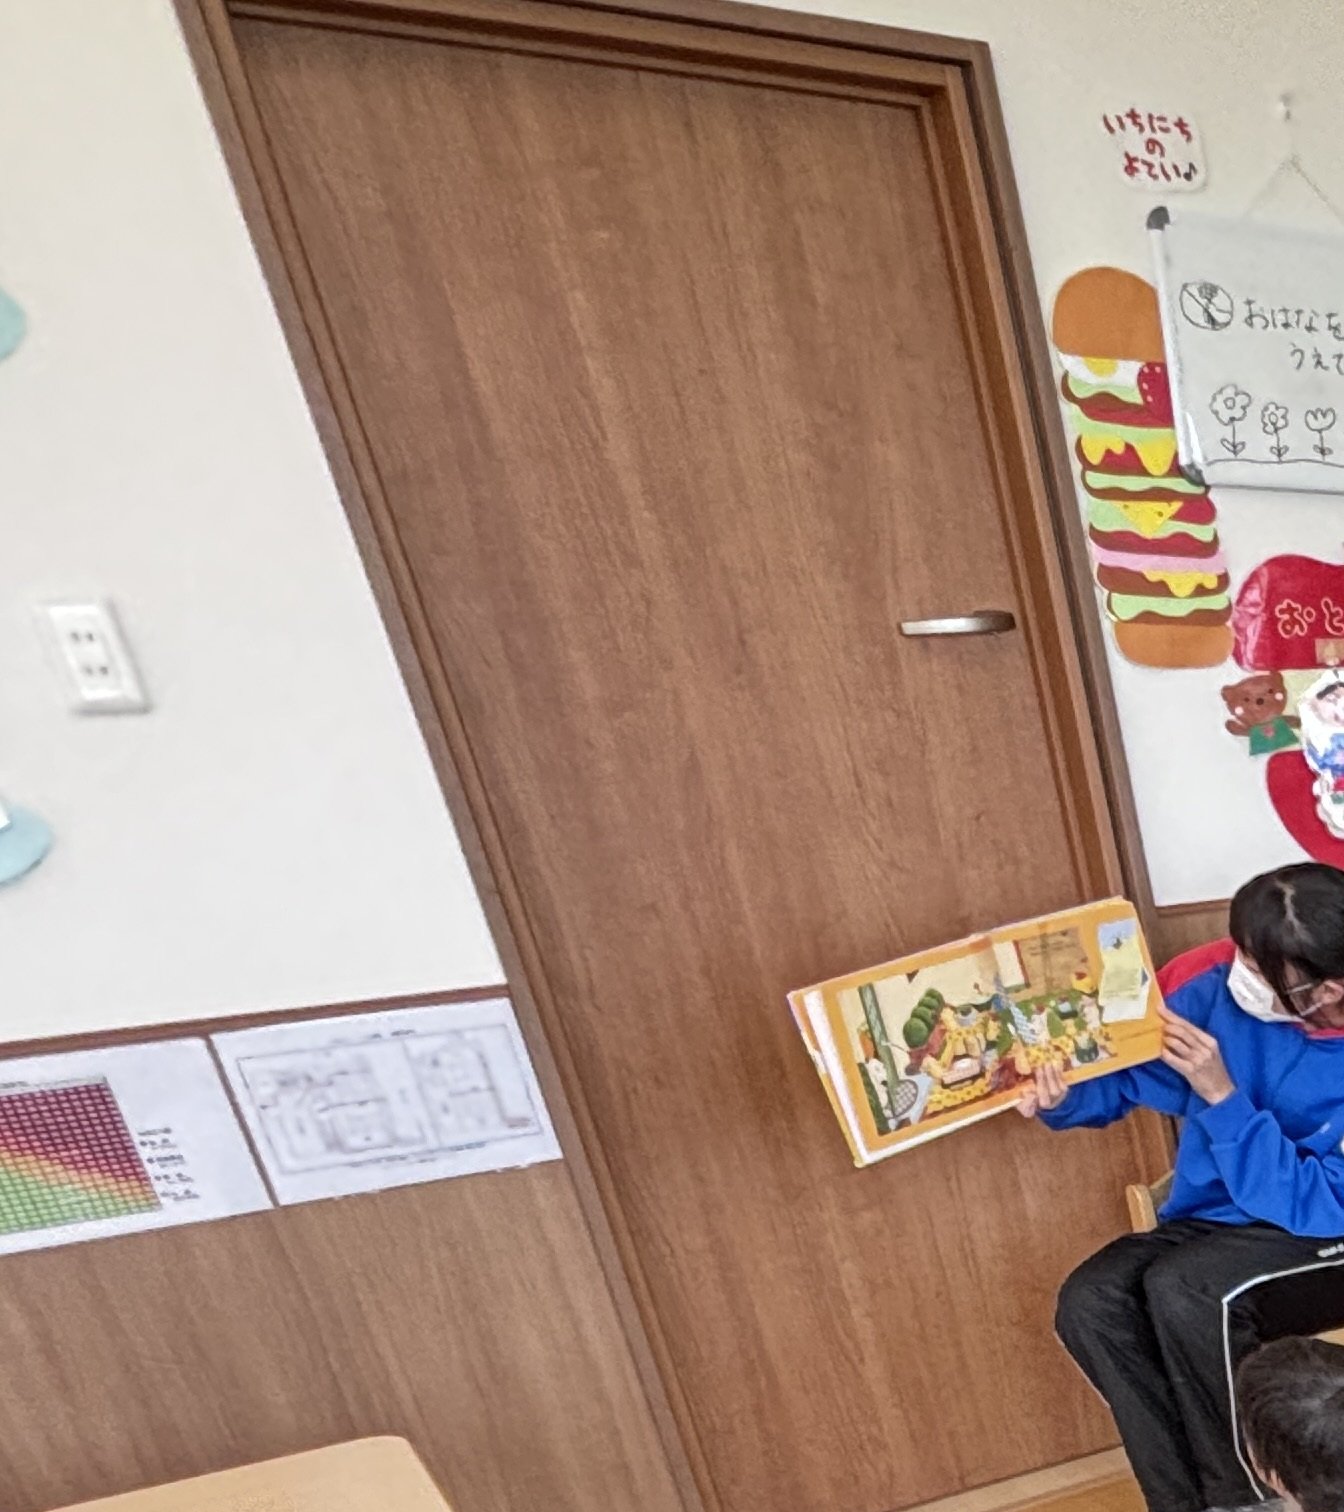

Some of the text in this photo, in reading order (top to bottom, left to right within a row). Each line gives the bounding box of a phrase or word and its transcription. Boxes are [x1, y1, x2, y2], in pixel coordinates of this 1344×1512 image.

[1102, 107, 1193, 144] いちにち
[1145, 137, 1166, 159] の
